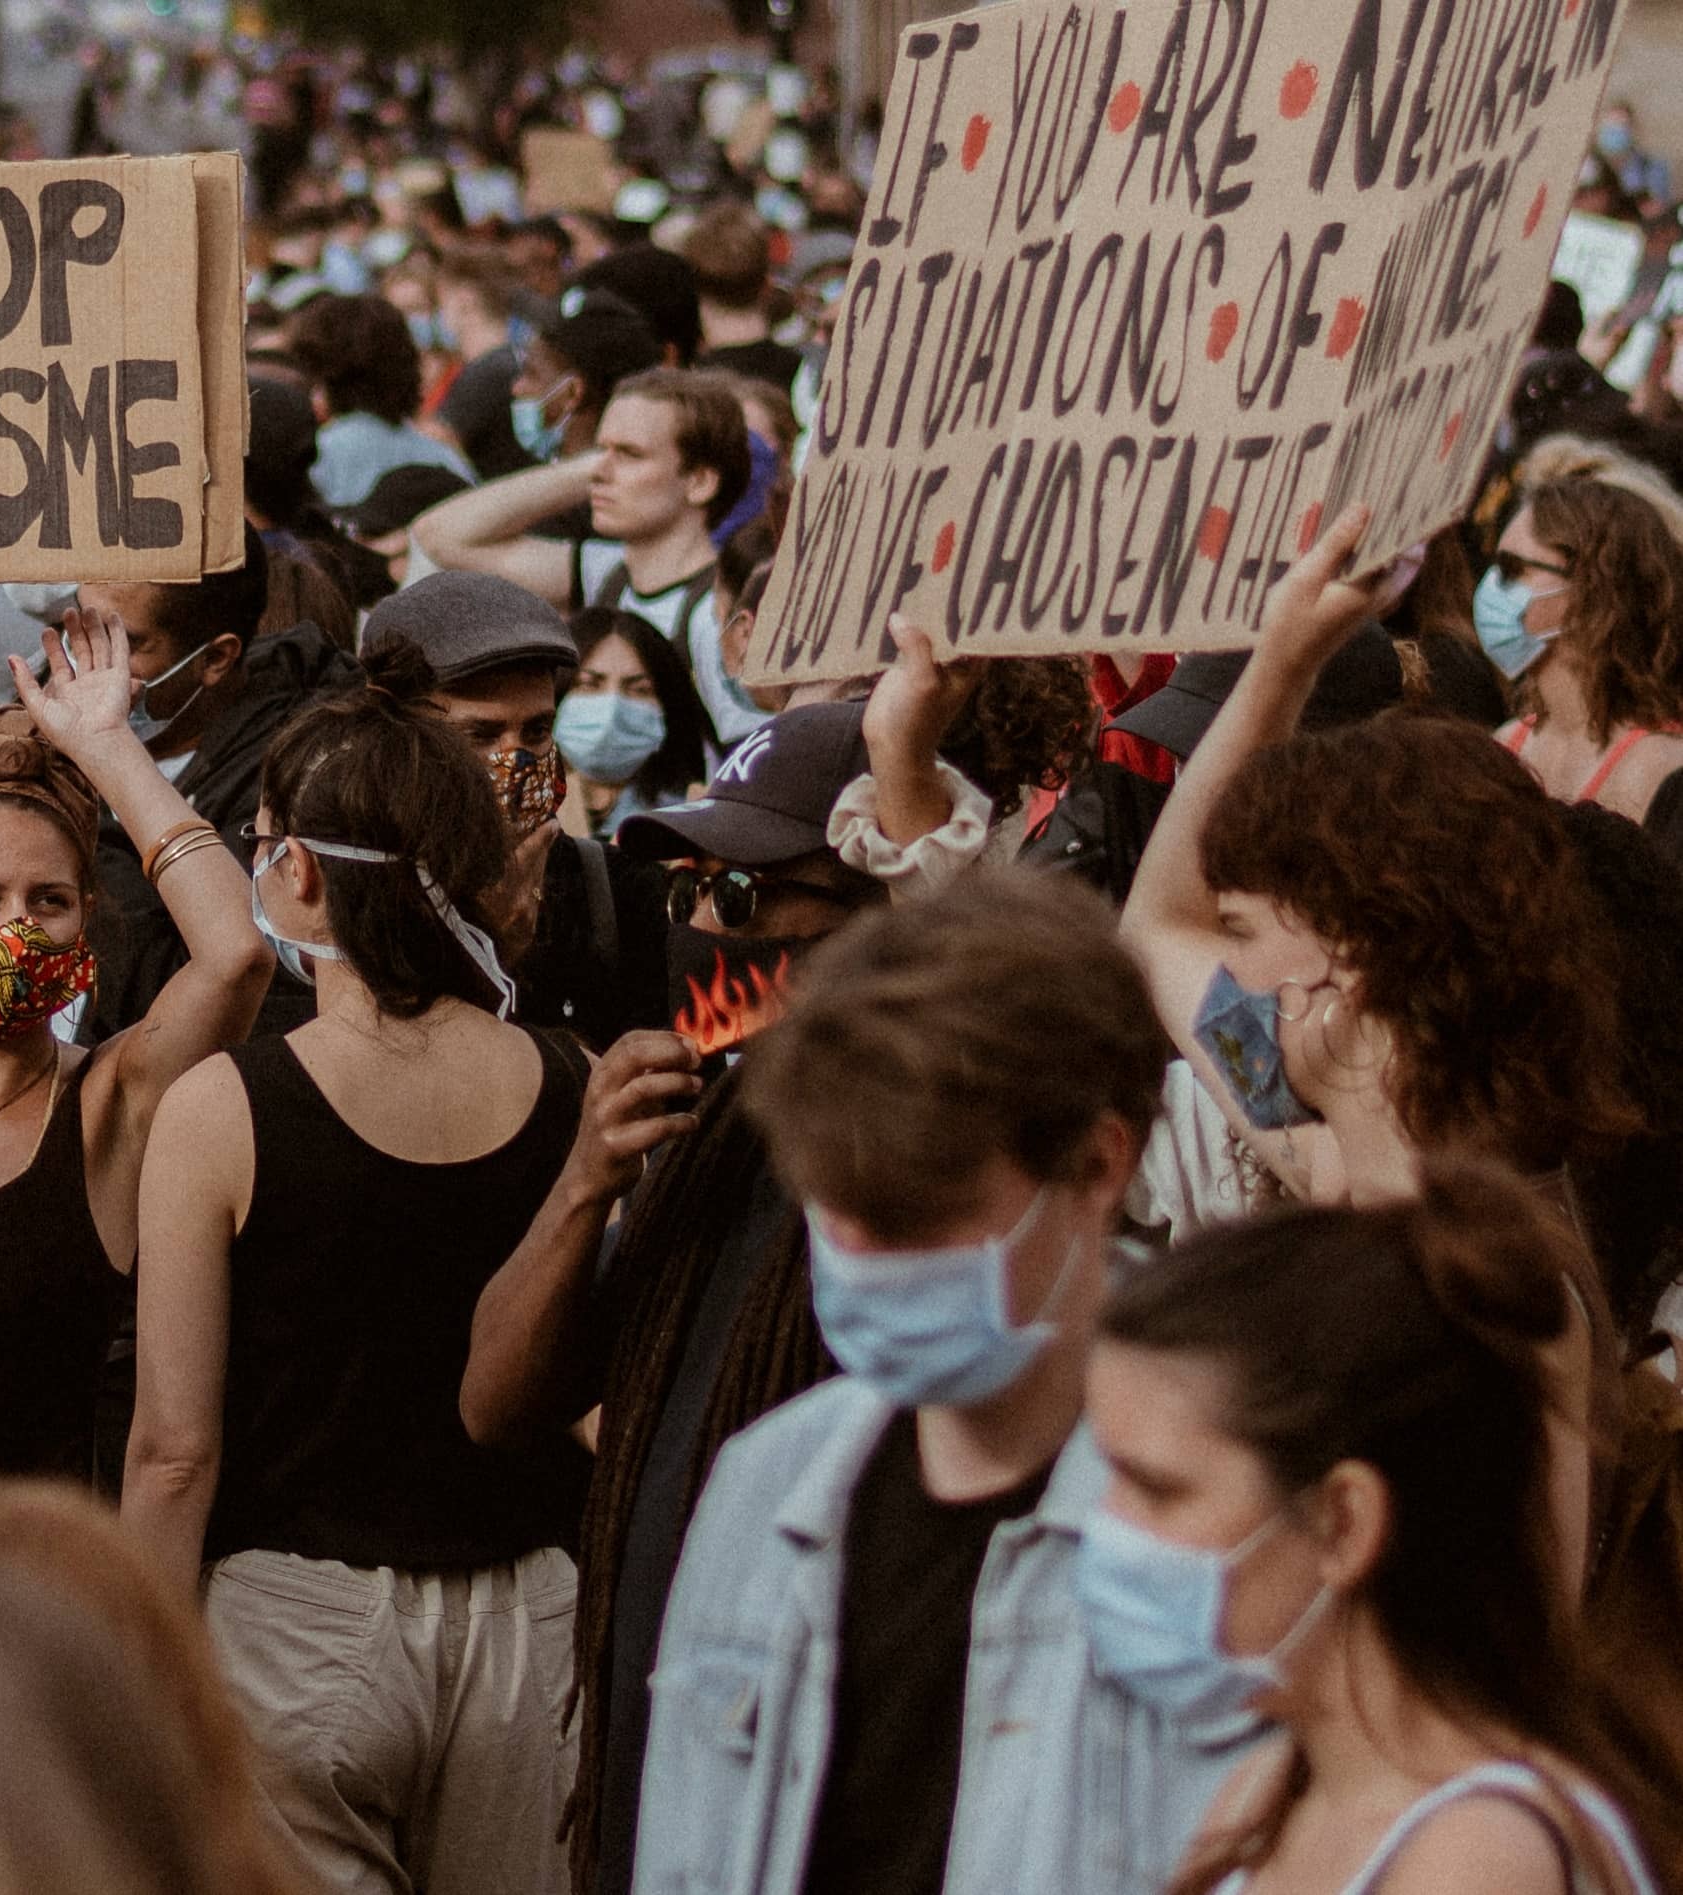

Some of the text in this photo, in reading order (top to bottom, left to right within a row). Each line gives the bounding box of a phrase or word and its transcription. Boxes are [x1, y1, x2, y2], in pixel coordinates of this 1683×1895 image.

[867, 21, 981, 249] IF
[985, 4, 1128, 247] YOU
[1115, 0, 1267, 219] ARE
[818, 223, 1225, 458] SITUATIONS
[1237, 221, 1347, 412] OF
[944, 431, 1230, 646] CHOSEN
[1201, 420, 1333, 633] THE
